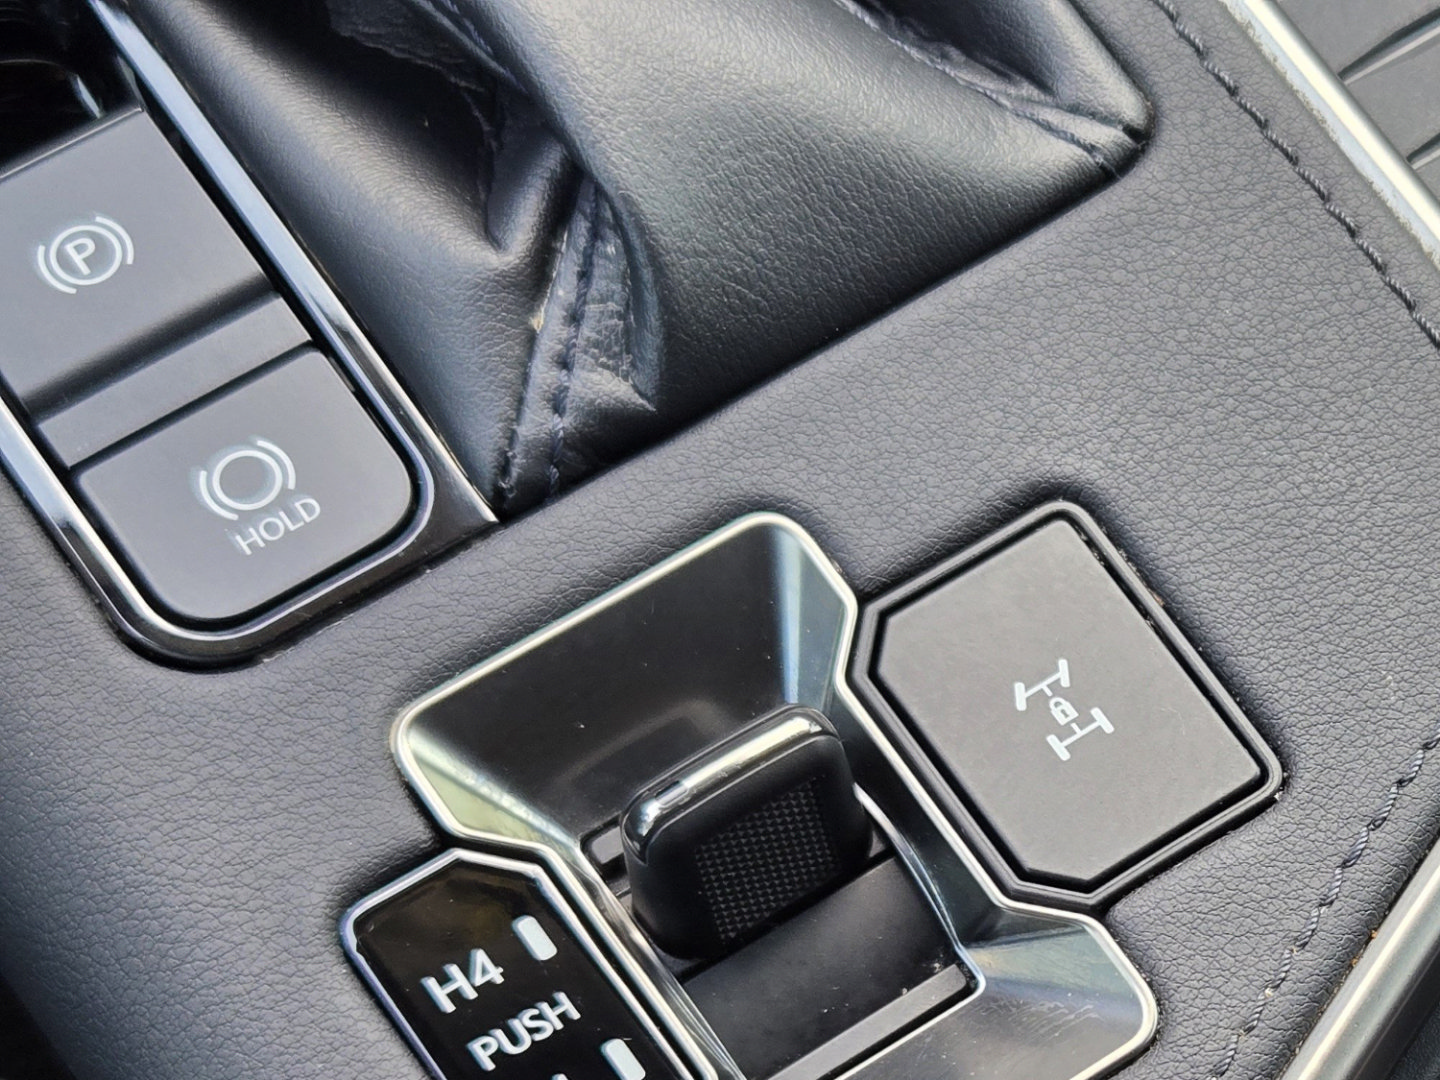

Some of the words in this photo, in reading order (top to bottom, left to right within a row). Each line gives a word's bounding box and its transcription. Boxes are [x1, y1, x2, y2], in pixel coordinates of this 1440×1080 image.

[64, 237, 96, 276] P
[235, 497, 321, 556] HOLD
[420, 947, 505, 1014] H4
[466, 991, 582, 1072] PUSH
